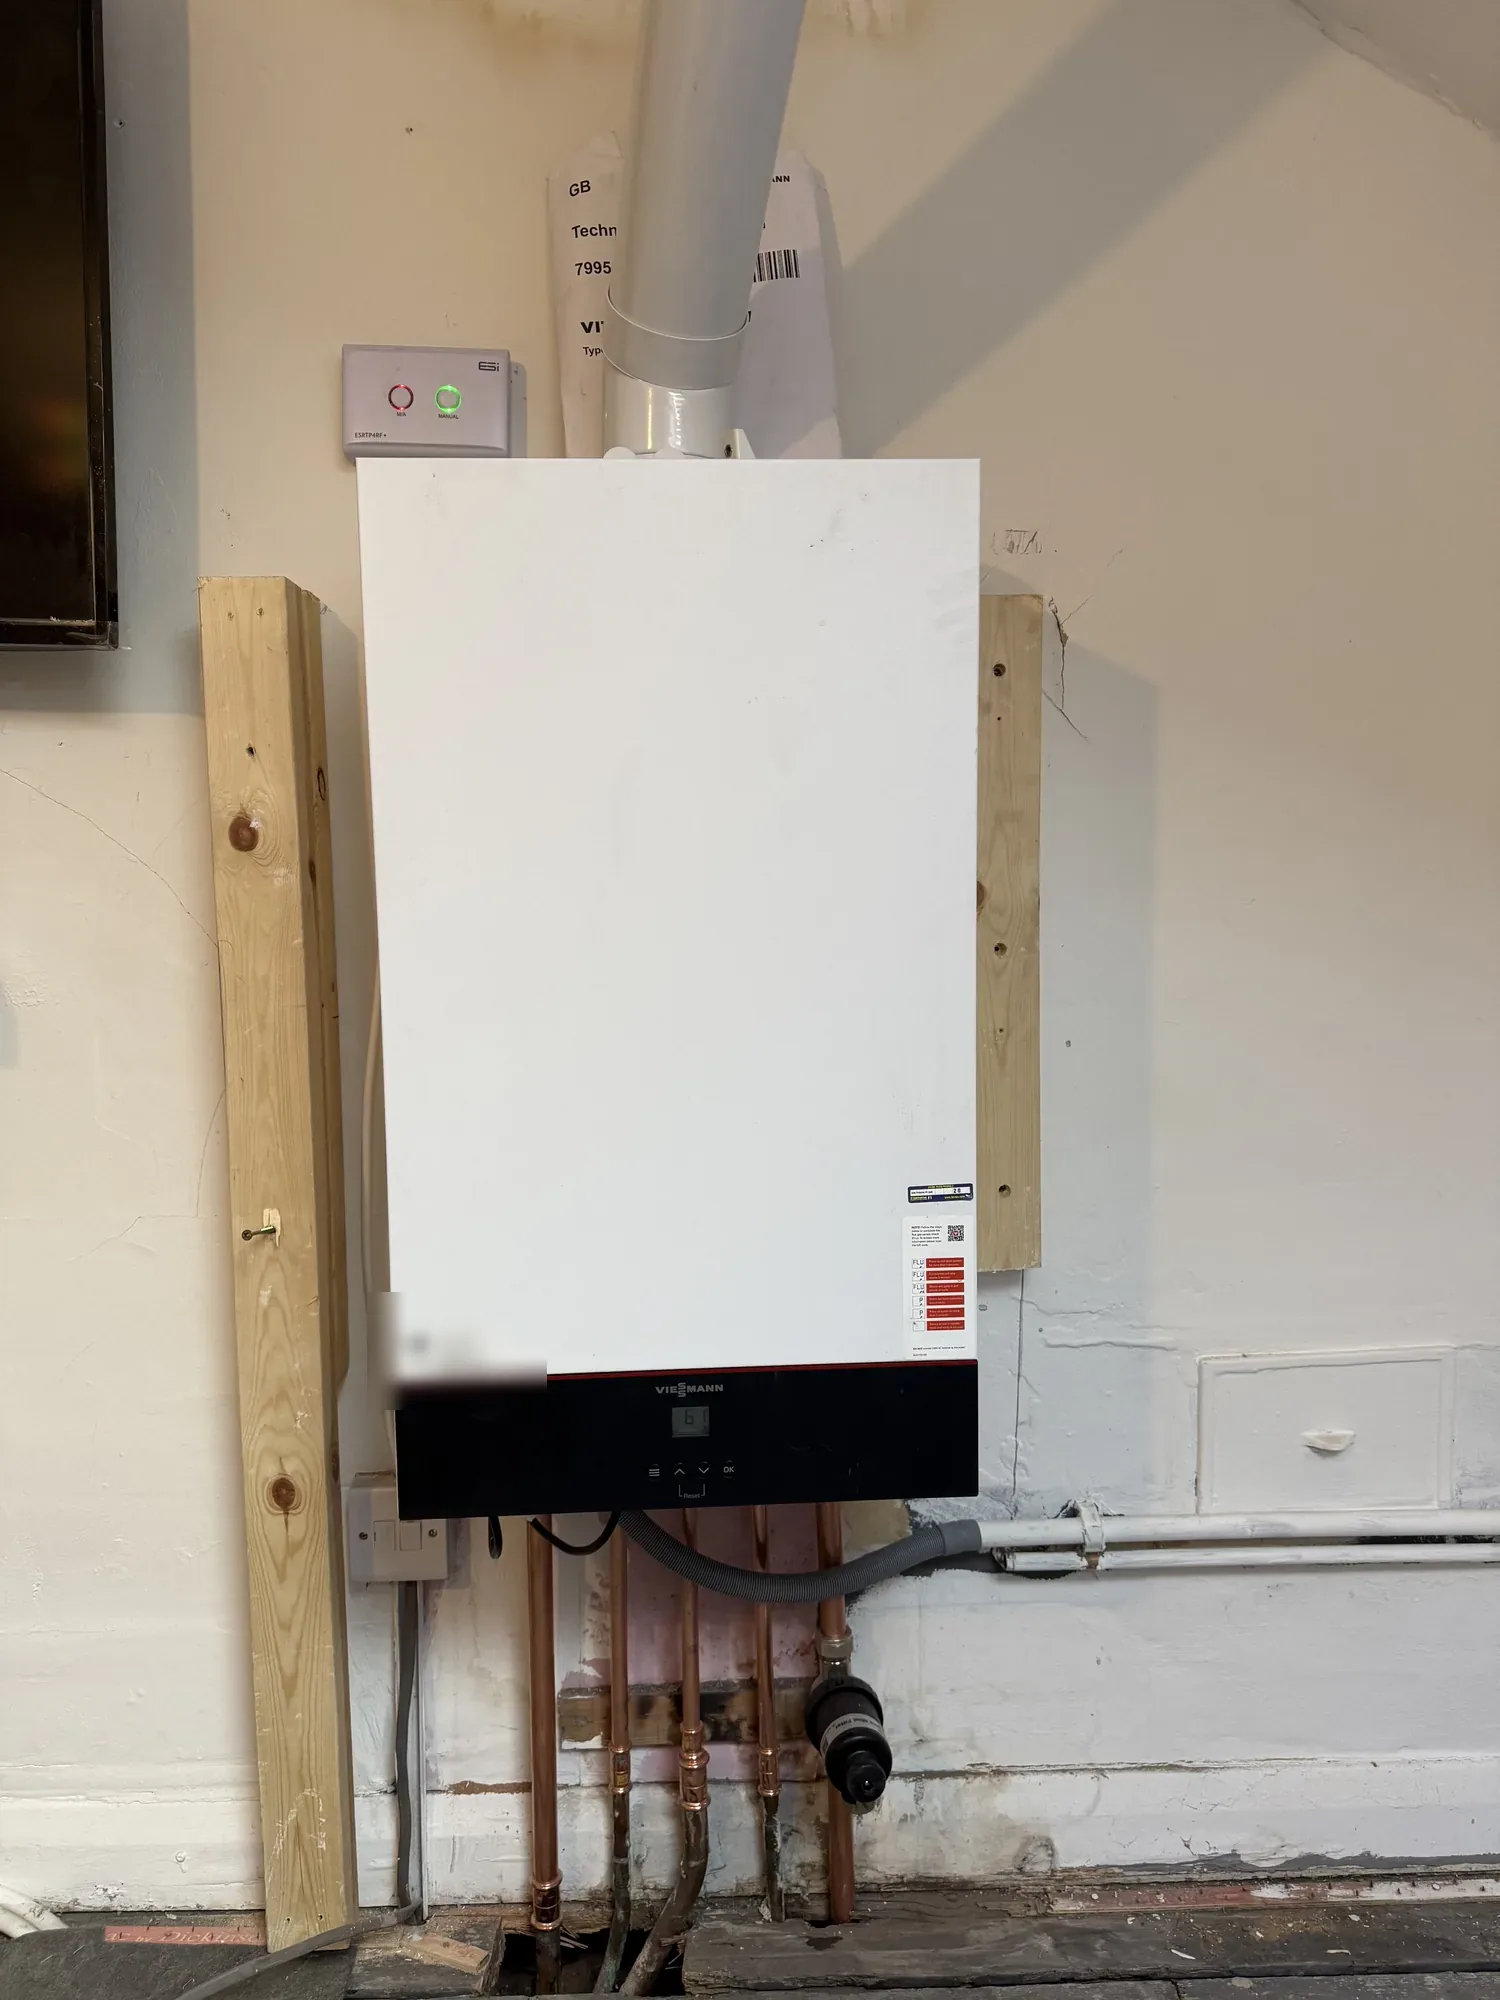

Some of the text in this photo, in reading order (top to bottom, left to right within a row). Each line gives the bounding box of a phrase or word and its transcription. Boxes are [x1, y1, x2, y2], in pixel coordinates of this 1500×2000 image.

[569, 180, 591, 197] GB
[571, 223, 617, 239] Techn
[574, 261, 612, 276] 7995
[580, 320, 605, 334] VI
[655, 1382, 724, 1398] VIESSMANN
